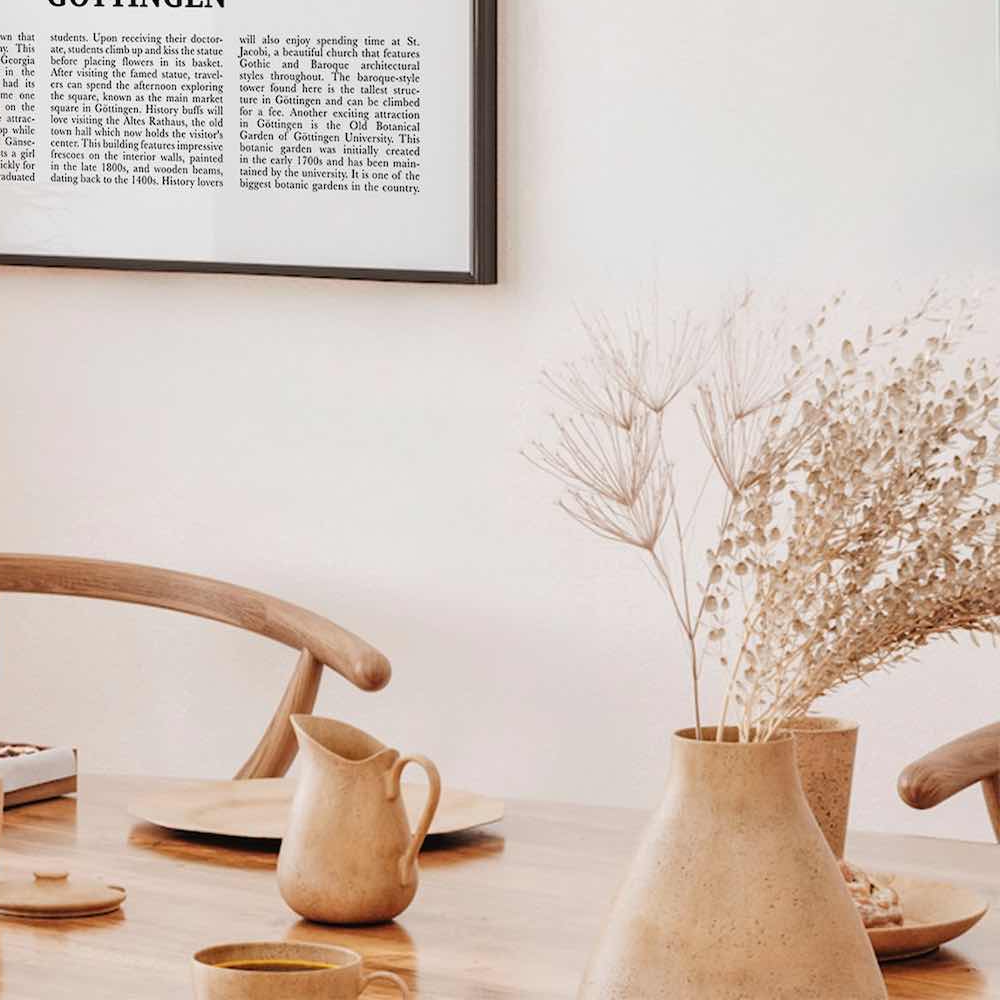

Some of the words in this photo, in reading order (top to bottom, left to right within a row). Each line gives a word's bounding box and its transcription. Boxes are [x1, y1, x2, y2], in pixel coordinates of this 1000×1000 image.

[17, 31, 35, 40] that
[93, 33, 117, 44] Upon
[121, 33, 162, 45] receiving
[165, 34, 186, 43] their
[285, 36, 311, 47] enjoy
[316, 36, 358, 47] spending
[16, 43, 35, 52] This
[67, 44, 103, 54] students
[105, 45, 130, 54] climb
[163, 46, 179, 54] kiss
[196, 47, 223, 55] statue
[282, 48, 323, 57] beautiful
[326, 48, 358, 57] church
[383, 49, 420, 58] features
[0, 55, 35, 66] Georgia
[50, 56, 78, 65] before
[84, 56, 116, 68] placing
[122, 57, 154, 66] flowers
[239, 59, 270, 68] Gothic
[311, 60, 349, 72] Baroque
[360, 61, 420, 70] architectural
[50, 68, 73, 77] After
[76, 68, 108, 80] visiting
[130, 69, 157, 78] famed
[239, 71, 264, 83] styles
[357, 73, 420, 84] baroque-style
[86, 80, 112, 91] spend
[133, 81, 177, 90] afternoon
[180, 82, 223, 93] exploring
[239, 84, 265, 92] tower
[270, 84, 296, 93] found
[360, 85, 387, 94] tallest
[102, 92, 132, 101] known
[165, 93, 188, 102] main
[192, 94, 223, 103] market
[382, 97, 420, 107] climbed
[50, 106, 79, 115] square
[145, 105, 179, 116] History
[182, 105, 204, 114] buffs
[206, 106, 223, 115] will
[289, 108, 327, 117] Another
[332, 109, 369, 120] exciting
[374, 110, 420, 119] attraction
[50, 115, 68, 124] love
[71, 115, 103, 127] visiting
[123, 116, 145, 125] Altes
[376, 122, 420, 131] Botanical
[12, 125, 35, 134] while
[50, 128, 72, 136] town
[94, 128, 120, 137] which
[145, 128, 169, 138] holds
[239, 131, 274, 141] Garden
[102, 140, 139, 151] building
[140, 140, 175, 150] features
[177, 141, 223, 153] impressive
[239, 143, 273, 153] botanic
[280, 144, 312, 156] garden
[343, 145, 379, 157] initially
[385, 146, 420, 155] created
[20, 149, 35, 160] girl
[50, 150, 84, 160] frescoes
[122, 152, 155, 161] interior
[189, 153, 223, 164] painted
[270, 156, 293, 167] early
[297, 156, 323, 166] 1700s
[102, 163, 129, 174] 1800s,
[153, 164, 188, 174] wooden
[239, 167, 268, 177] tained
[50, 174, 78, 186] dating
[132, 176, 159, 185] 1400s.
[162, 176, 195, 188] History
[197, 177, 223, 186] lovers
[239, 179, 271, 191] biggest
[274, 180, 308, 190] botanic
[311, 181, 348, 193] gardens
